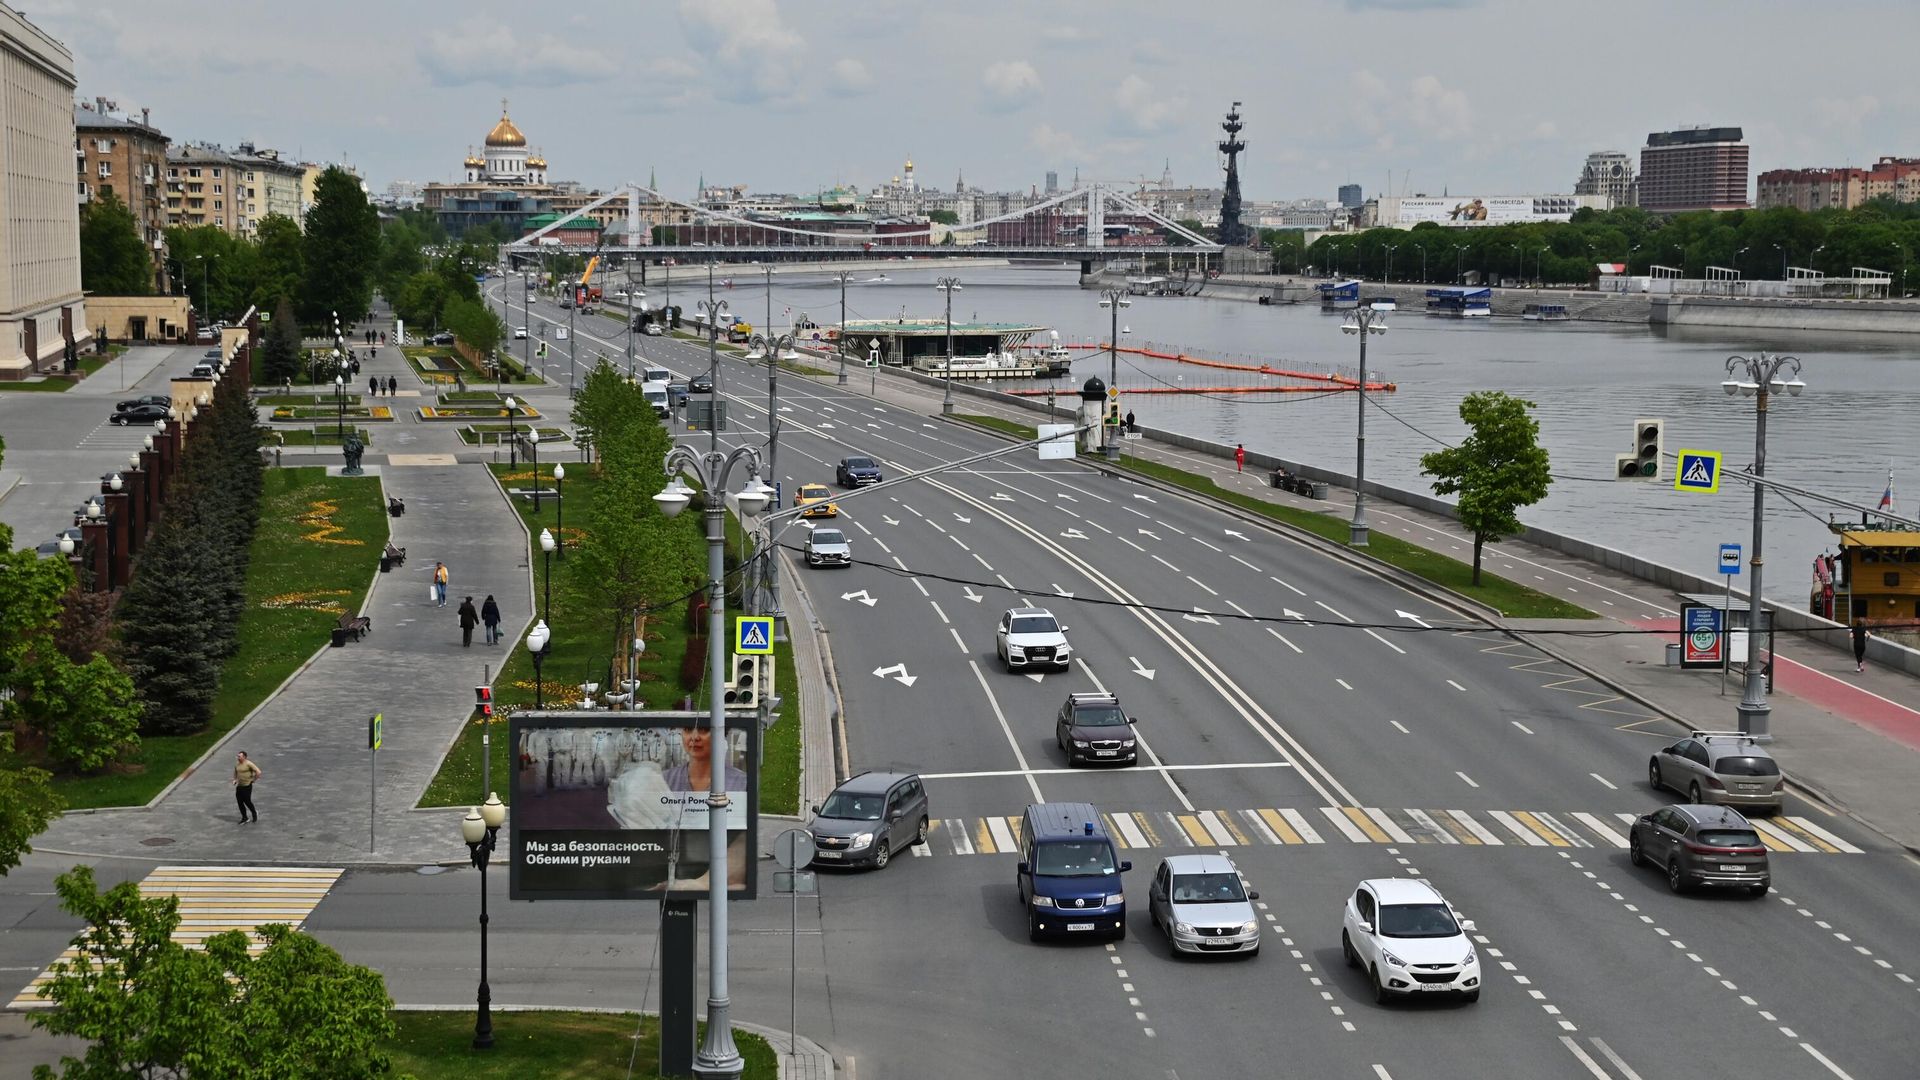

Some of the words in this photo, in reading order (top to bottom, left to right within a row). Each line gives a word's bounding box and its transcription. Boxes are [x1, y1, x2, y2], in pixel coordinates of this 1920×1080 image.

[1695, 632, 1711, 641] 65+
[660, 796, 686, 805] Ольга
[526, 841, 548, 852] Мы
[551, 843, 566, 852] за
[568, 841, 664, 852] безопасность.
[526, 854, 579, 865] Обеими
[581, 855, 631, 867] руками
